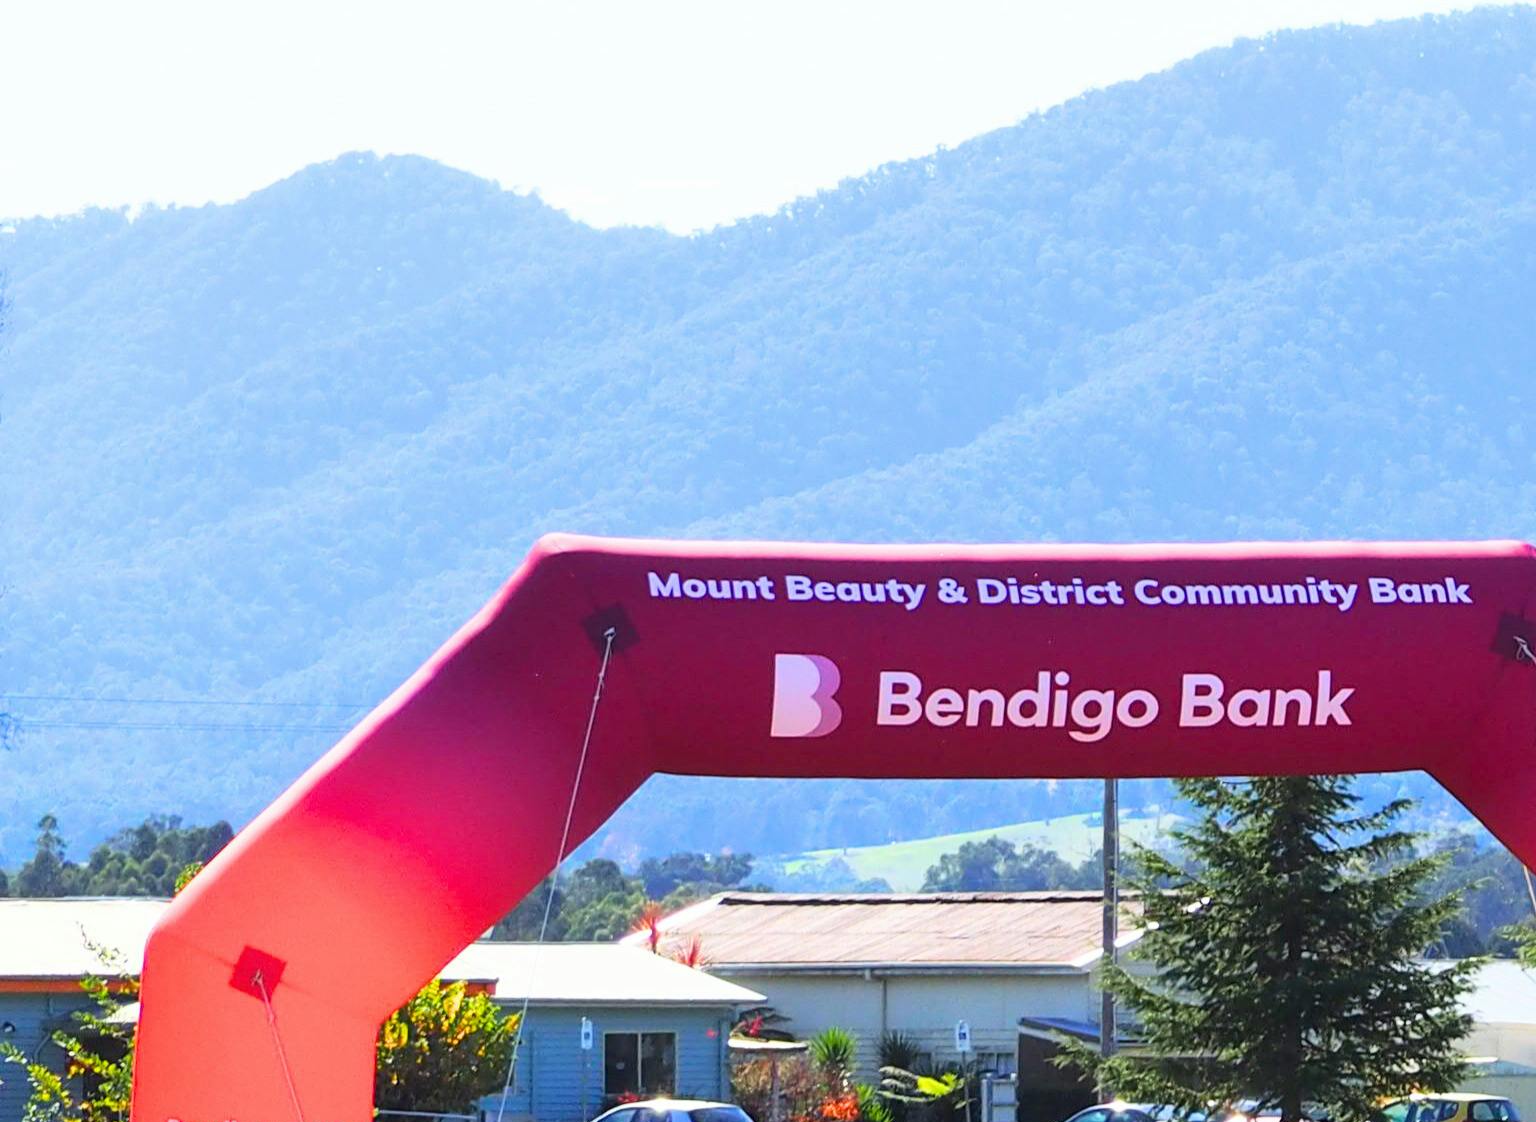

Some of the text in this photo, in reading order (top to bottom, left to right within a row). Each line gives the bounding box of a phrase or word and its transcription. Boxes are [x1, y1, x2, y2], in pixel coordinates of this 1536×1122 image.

[647, 572, 1473, 612] Mount Beauty & District Community Bank
[876, 670, 1160, 743] Bendigo
[1178, 669, 1356, 728] Bank
